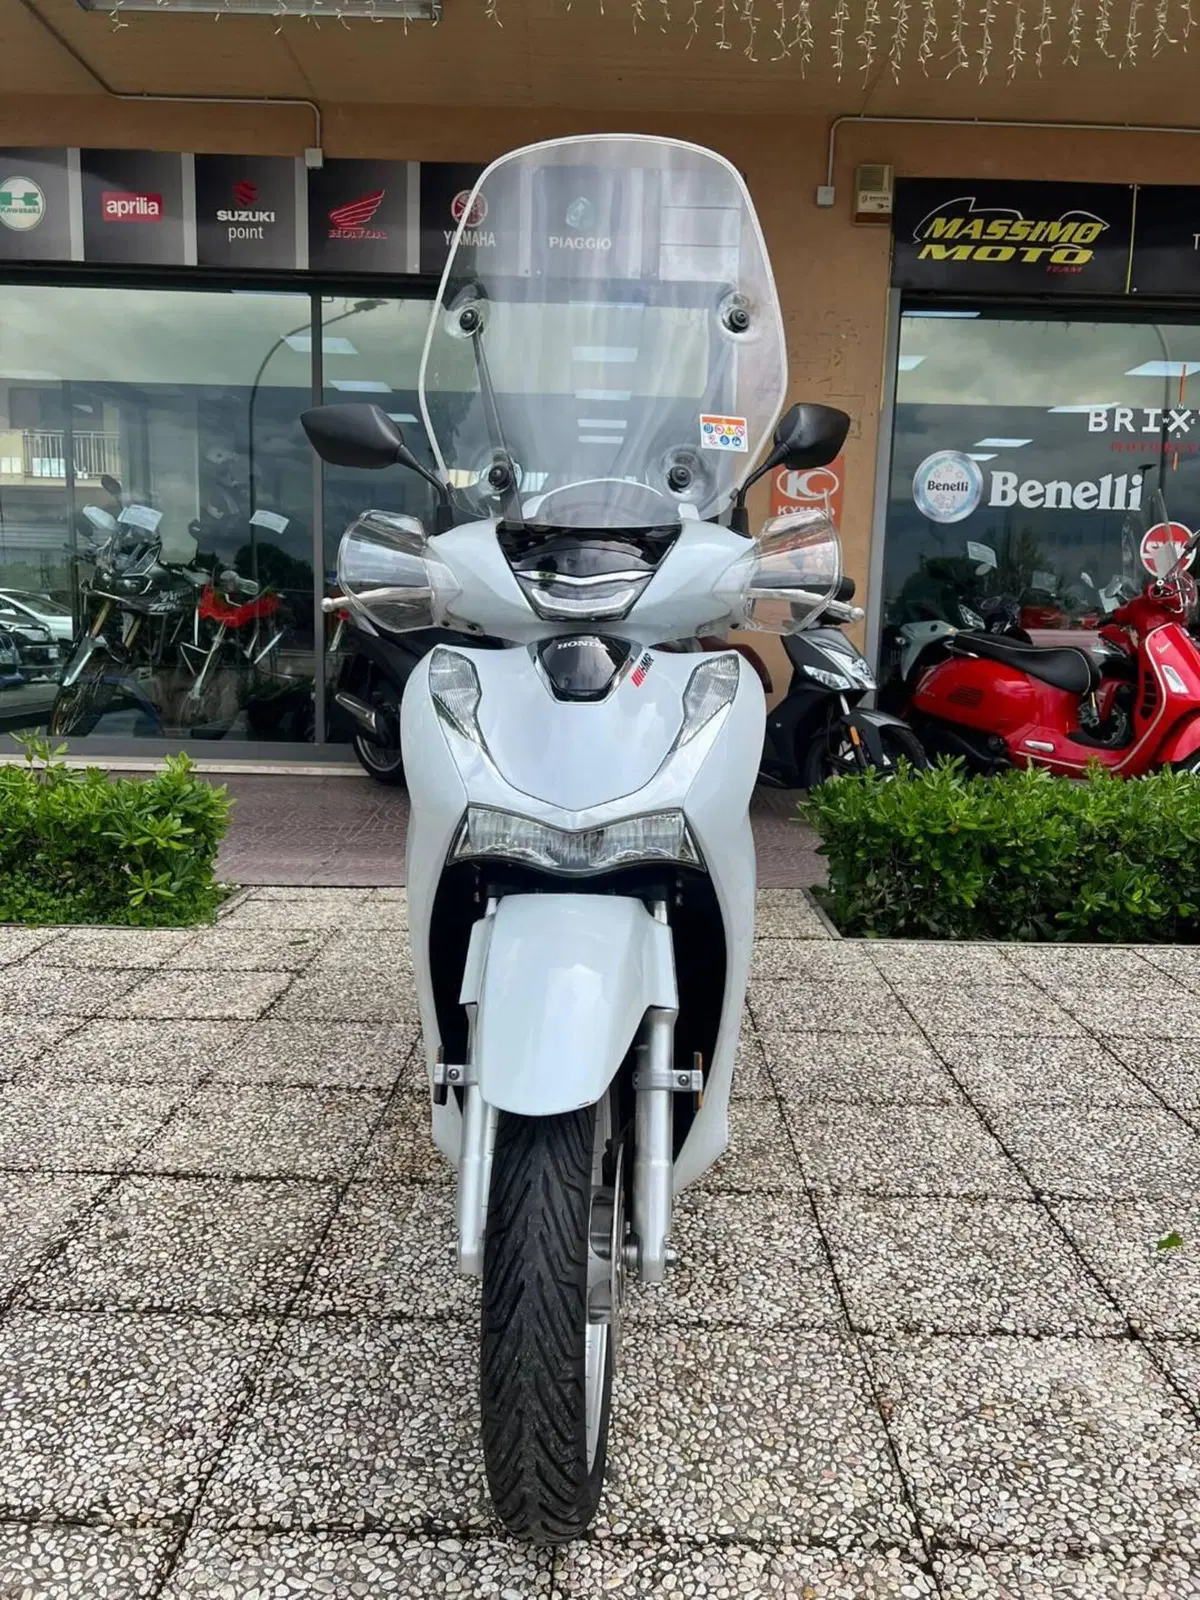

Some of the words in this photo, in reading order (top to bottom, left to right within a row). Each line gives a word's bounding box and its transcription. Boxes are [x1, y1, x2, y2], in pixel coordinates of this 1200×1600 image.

[106, 197, 159, 217] aprilia
[216, 210, 275, 222] SUZUKI
[228, 226, 264, 242] point
[923, 217, 1104, 243] MASSIMO
[549, 236, 612, 250] PIAGGIO
[917, 244, 1095, 264] MOTO
[927, 480, 969, 493] Benelli
[988, 471, 1144, 511] Benelli
[557, 640, 609, 650] HONDA
